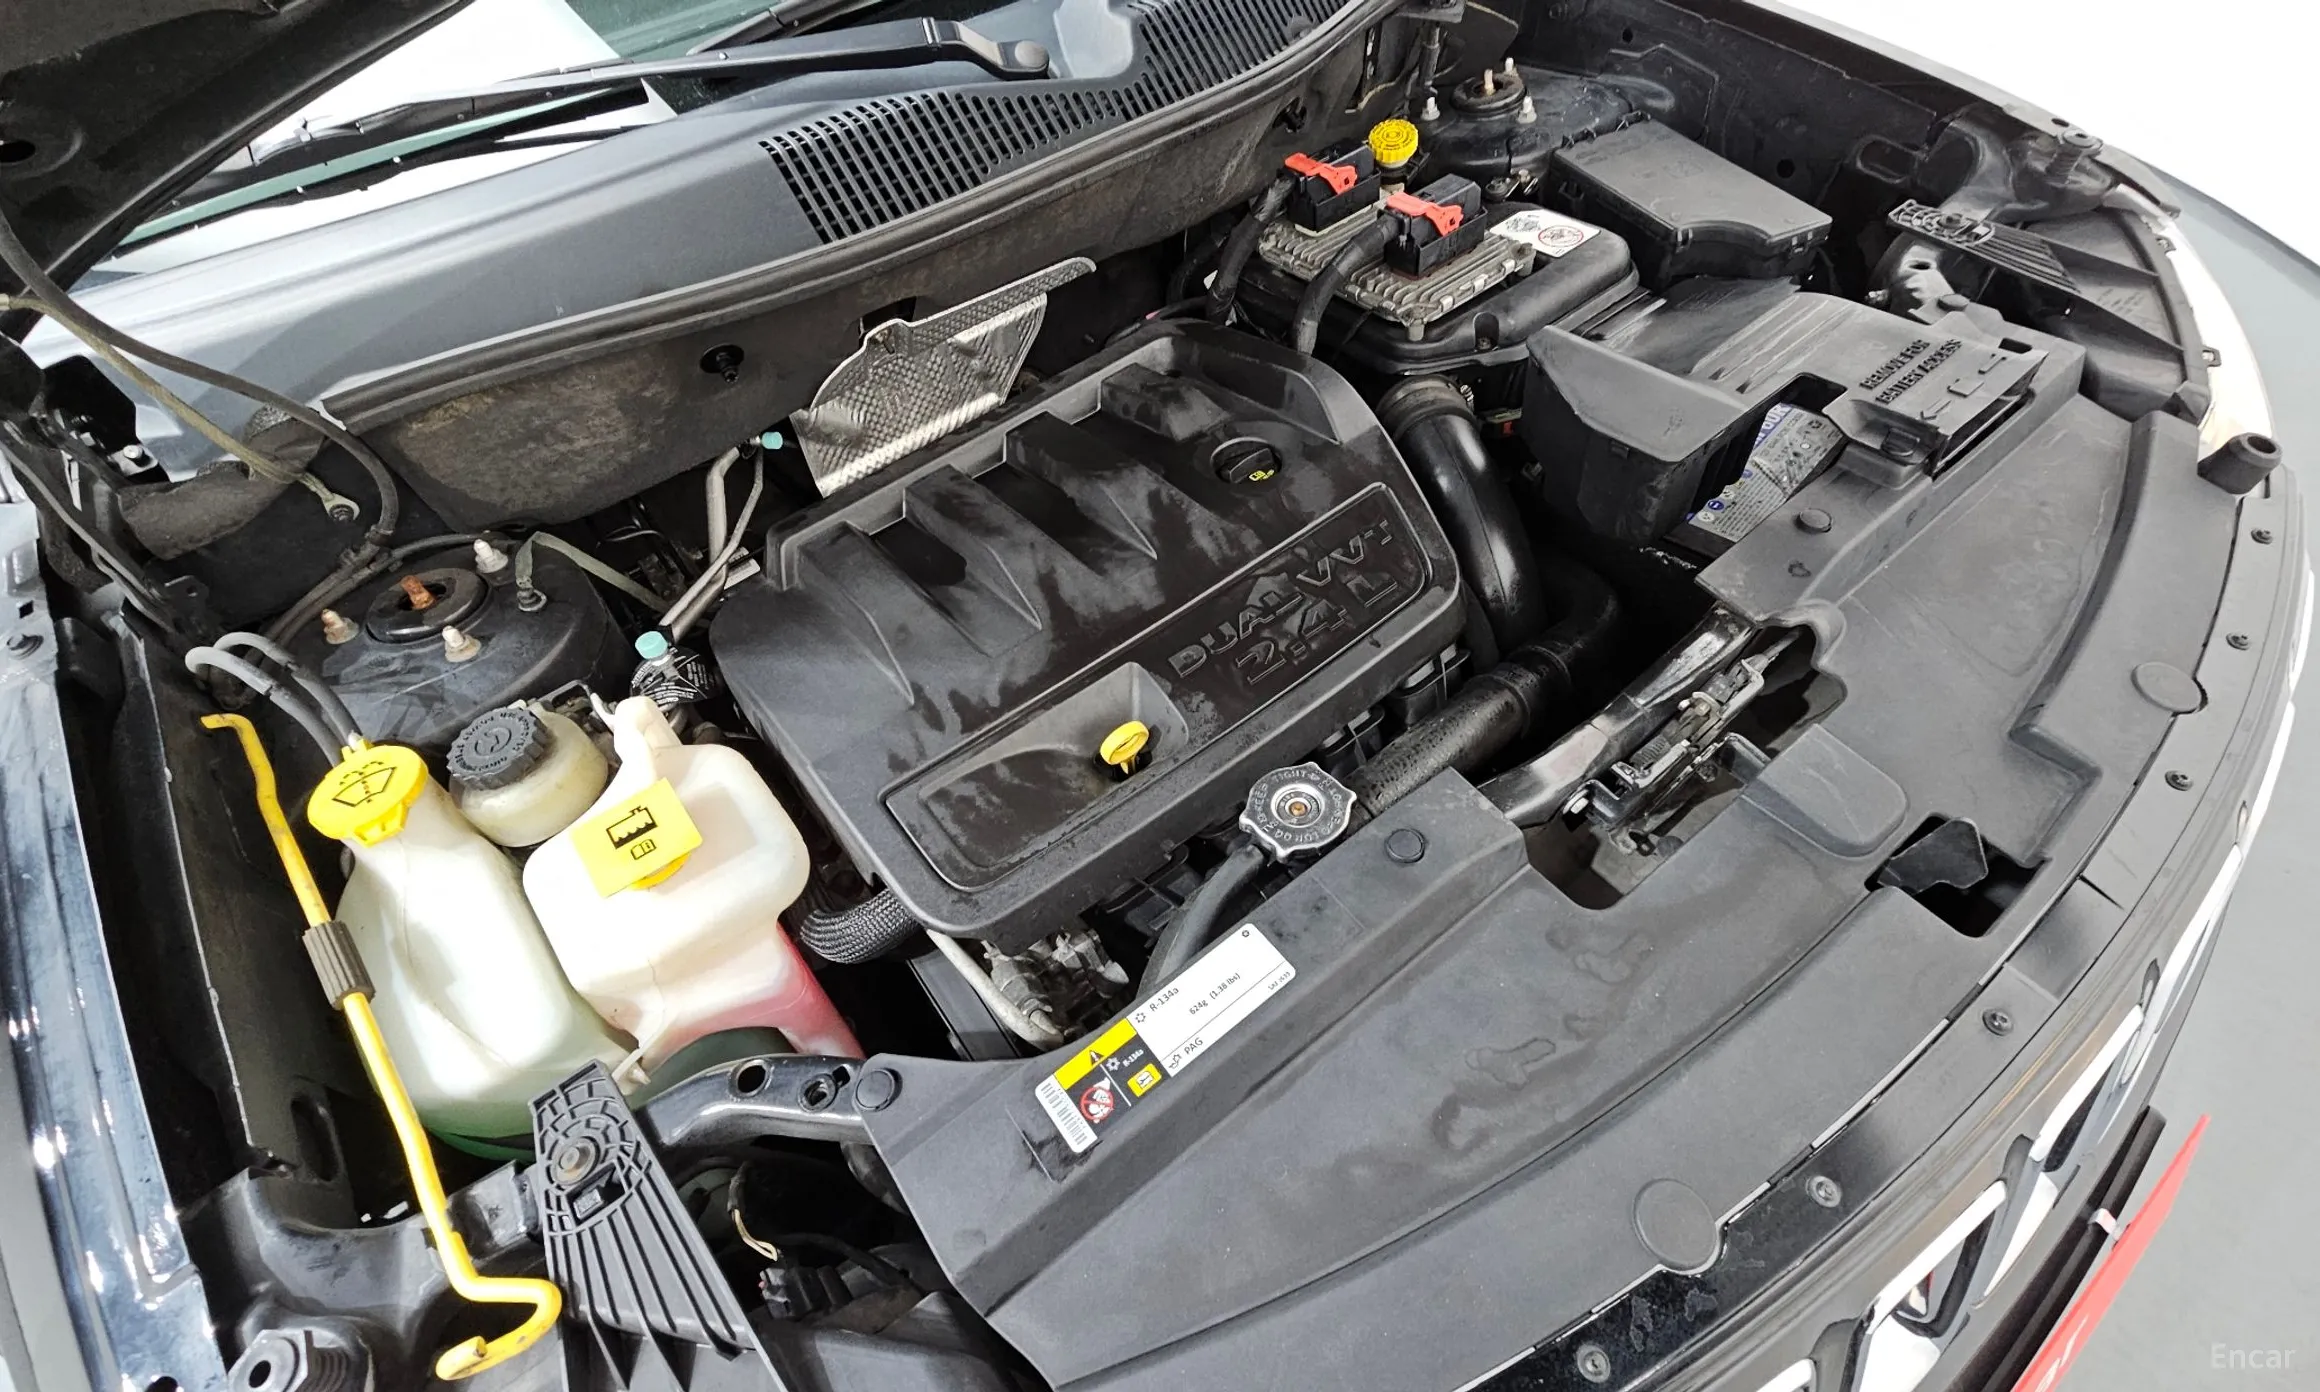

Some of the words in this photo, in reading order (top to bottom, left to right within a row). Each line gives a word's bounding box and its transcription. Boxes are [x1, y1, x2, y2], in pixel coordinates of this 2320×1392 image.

[1859, 355, 1908, 390] REMOVE
[1875, 369, 1925, 404] BATTERY
[1917, 339, 1962, 373] ACCESS
[1167, 590, 1303, 678] DUAL
[1296, 519, 1393, 586] VVT
[1149, 987, 1180, 1012] R-134a
[1189, 999, 1209, 1015] 624g
[1209, 982, 1228, 1000] (1.38
[1227, 972, 1241, 986] lbs)
[1122, 1049, 1144, 1067] R-134a
[1184, 1037, 1204, 1055] PAG
